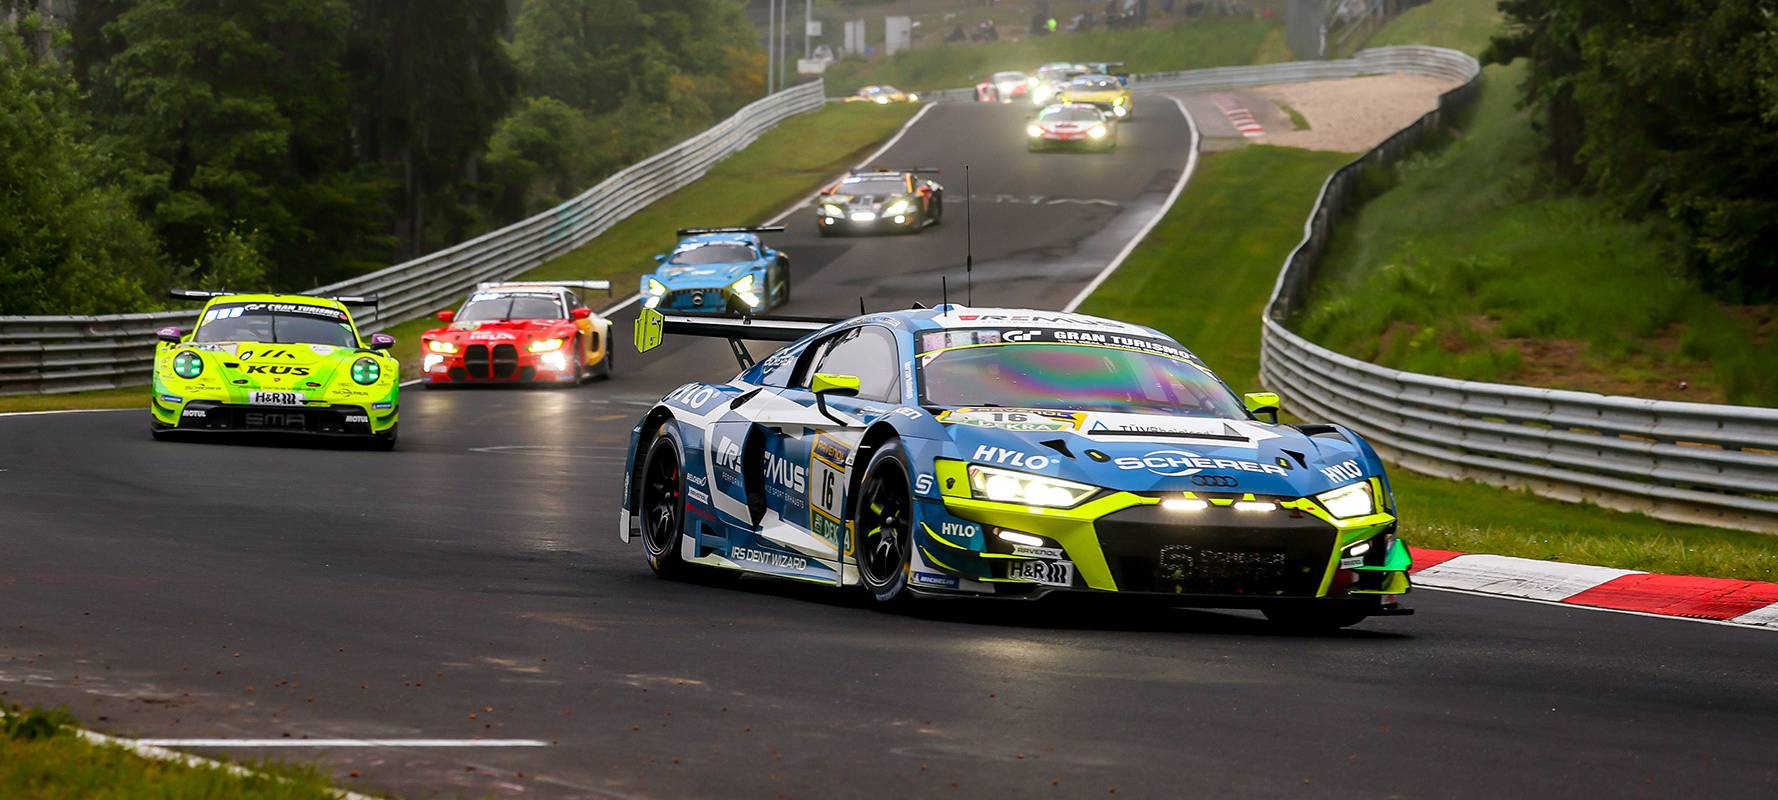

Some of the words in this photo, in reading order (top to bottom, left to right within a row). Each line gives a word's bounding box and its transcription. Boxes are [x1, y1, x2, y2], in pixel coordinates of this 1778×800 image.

[1053, 331, 1106, 343] GRAN
[1110, 335, 1190, 359] TURISMO
[255, 392, 280, 402] H&R
[345, 415, 368, 423] MOTUL
[991, 413, 1028, 422] 16
[973, 445, 1049, 470] HYLO
[1113, 456, 1288, 477] SCHERER
[1320, 461, 1362, 484] HYLO
[821, 469, 835, 510] 16
[942, 522, 975, 538] HYLO
[732, 546, 746, 561] IRS
[746, 549, 771, 564] DENT
[771, 554, 807, 571] WIZARD
[1017, 548, 1058, 556] RAVENOL
[1010, 562, 1044, 580] H&R
